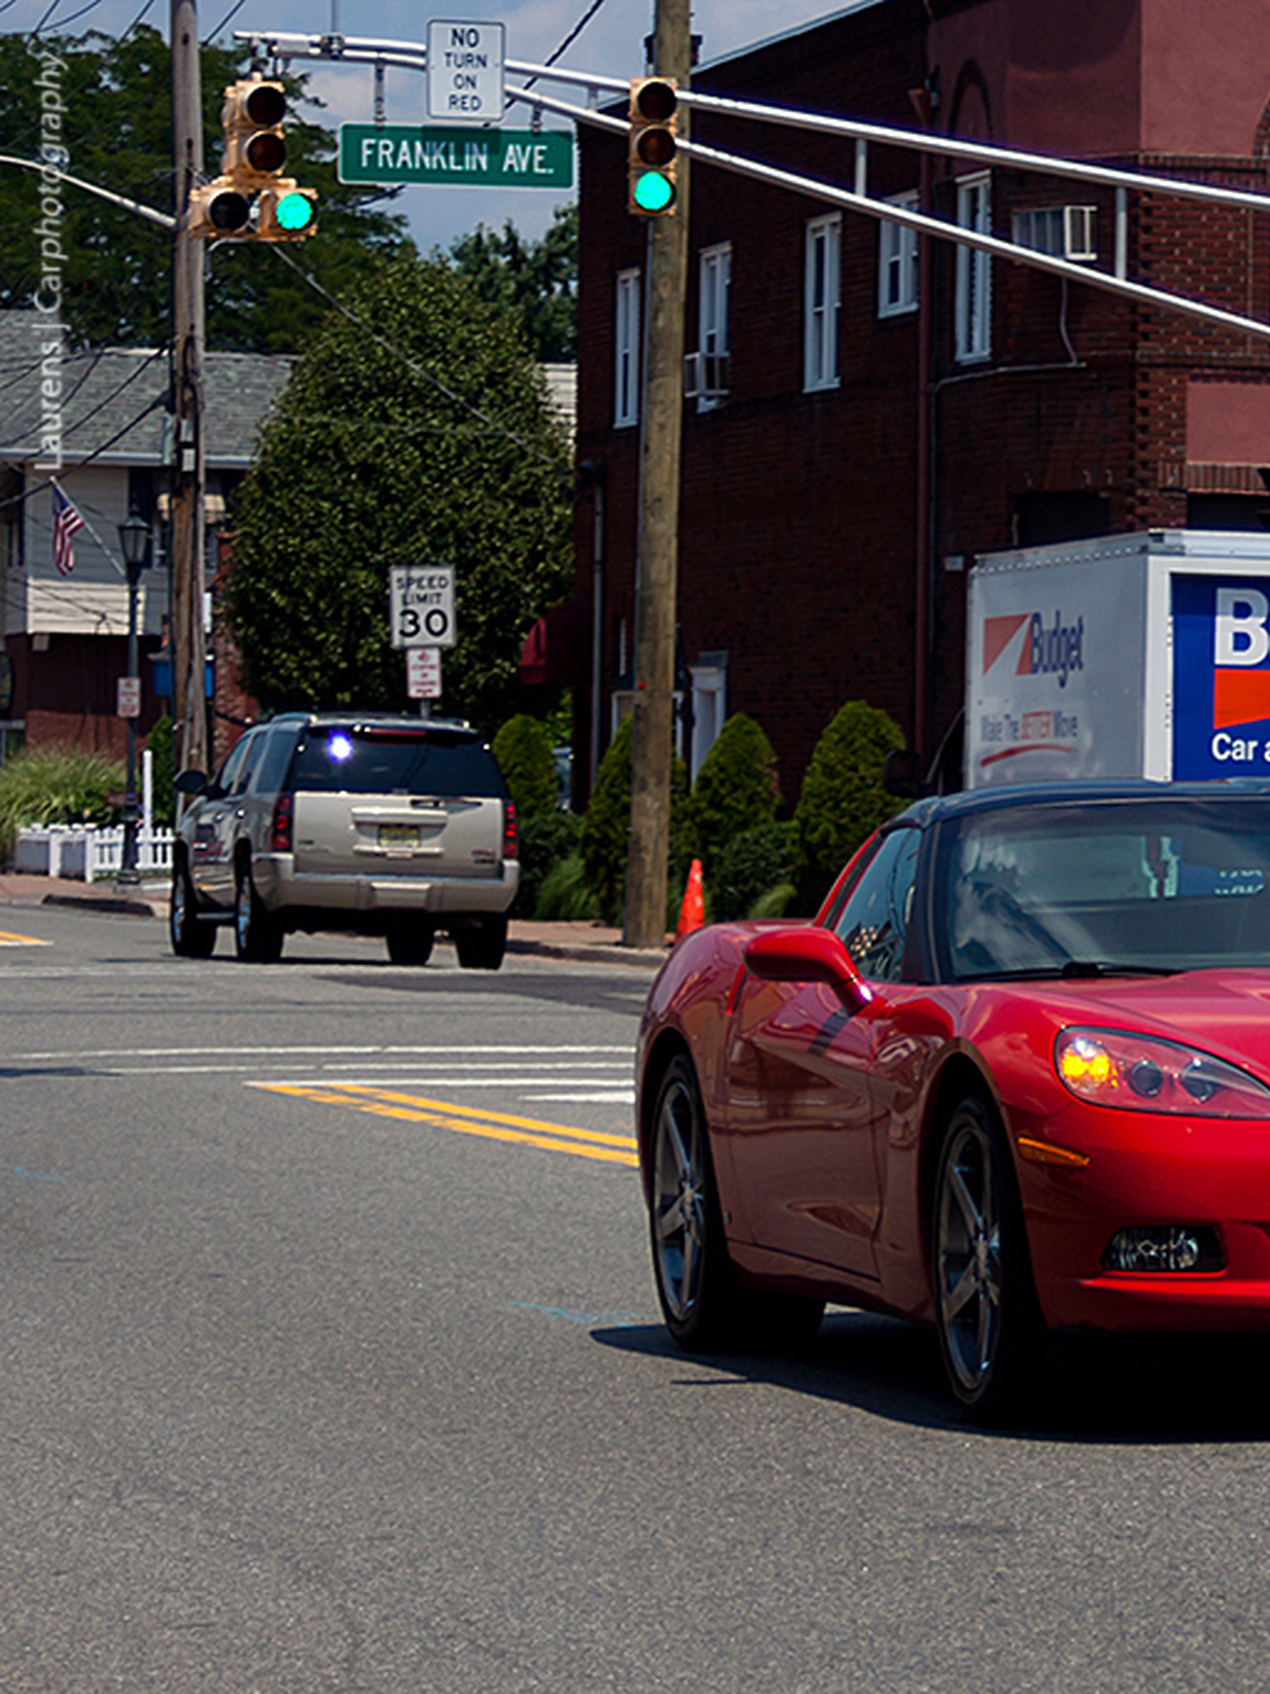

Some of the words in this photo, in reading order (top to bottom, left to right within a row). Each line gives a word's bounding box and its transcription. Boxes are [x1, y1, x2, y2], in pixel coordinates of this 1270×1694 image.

[451, 28, 480, 48] NO
[444, 52, 488, 68] TURN
[453, 74, 477, 90] ON
[448, 95, 482, 111] RED
[361, 138, 488, 172] FRANKLIN
[502, 144, 554, 174] AVE.
[395, 575, 448, 590] SPEED
[402, 592, 442, 606] LIMIT
[399, 608, 448, 637] 30
[1030, 610, 1083, 689] Budget
[1211, 732, 1258, 762] Car
